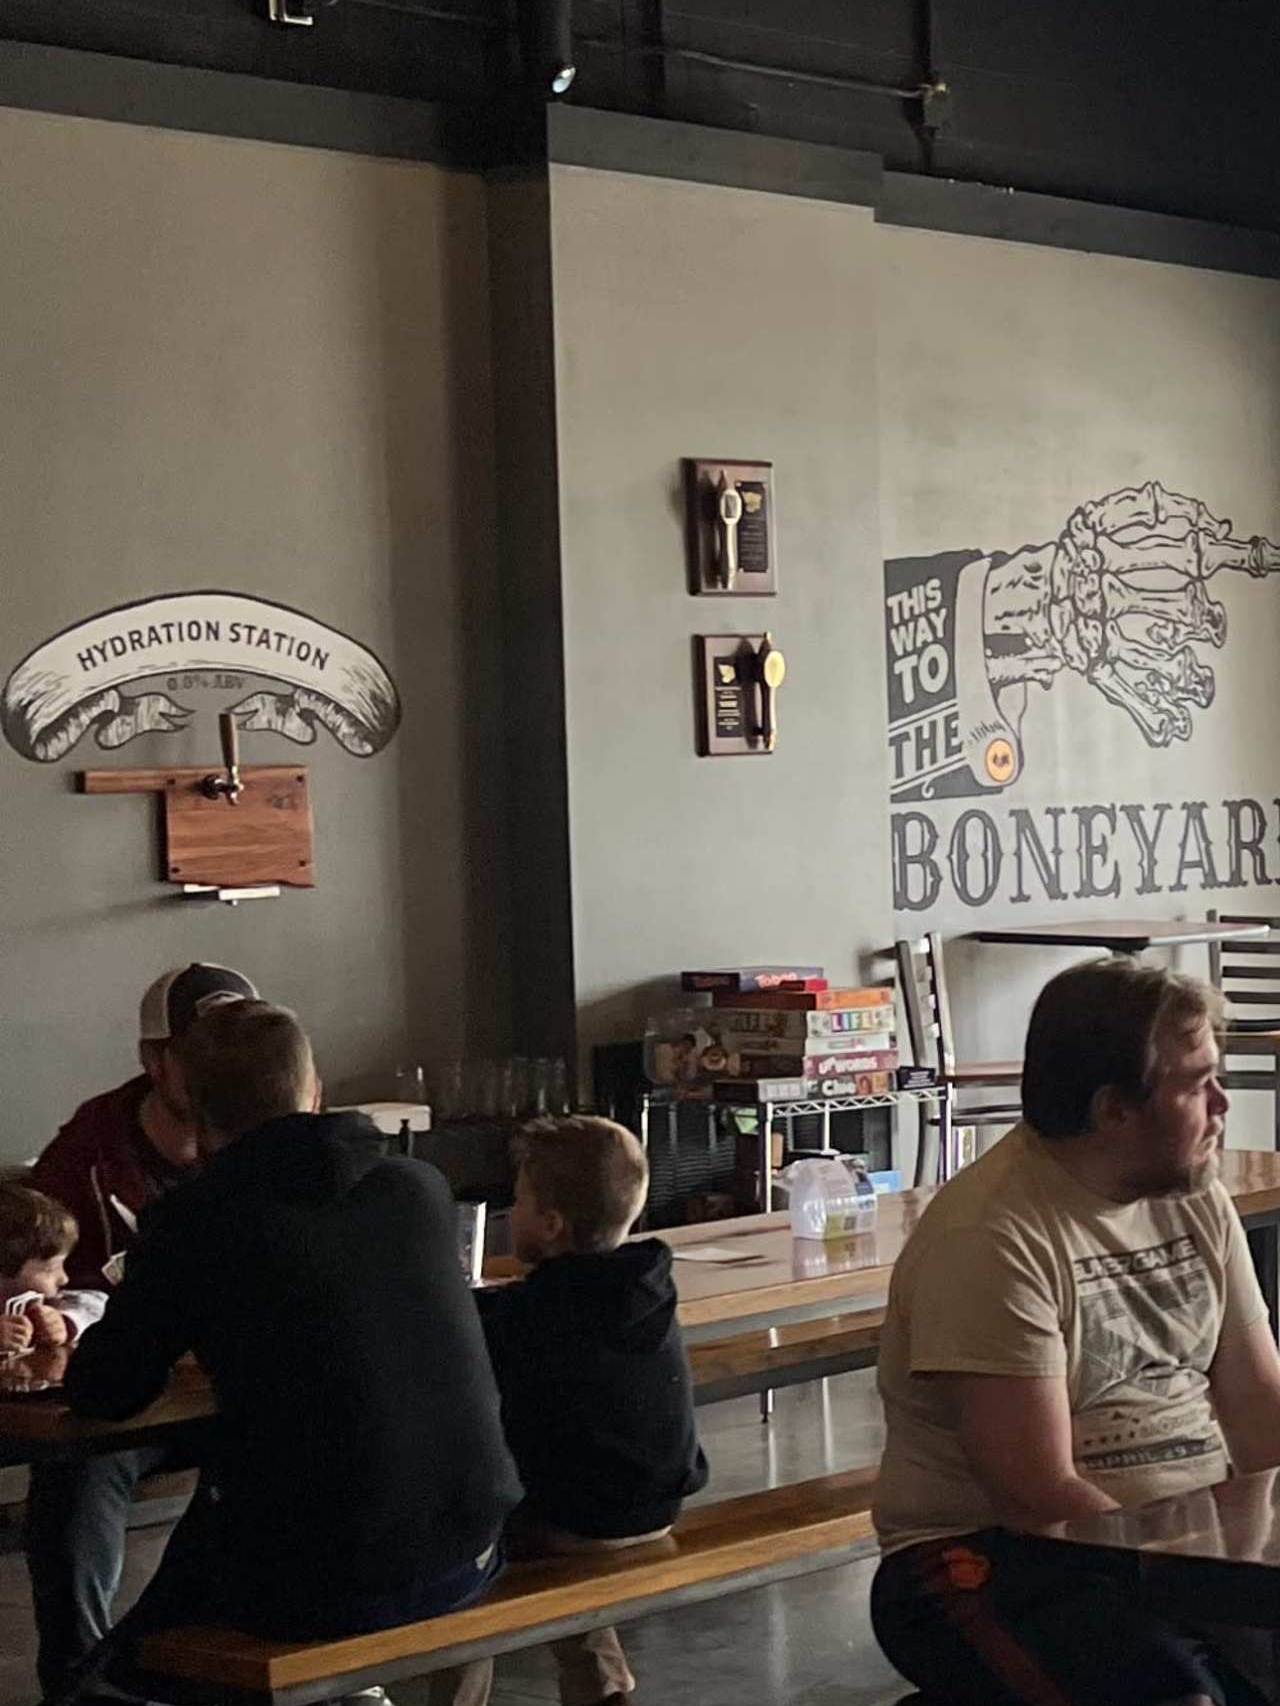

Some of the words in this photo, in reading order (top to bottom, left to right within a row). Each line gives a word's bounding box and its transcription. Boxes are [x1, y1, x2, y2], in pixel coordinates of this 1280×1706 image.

[887, 578, 942, 624] THIS
[78, 620, 219, 671] HYDRATION
[229, 622, 329, 670] STATION
[889, 611, 947, 658] WAY
[893, 643, 949, 706] TO
[890, 714, 960, 779] THE
[821, 1078, 857, 1096] Clue
